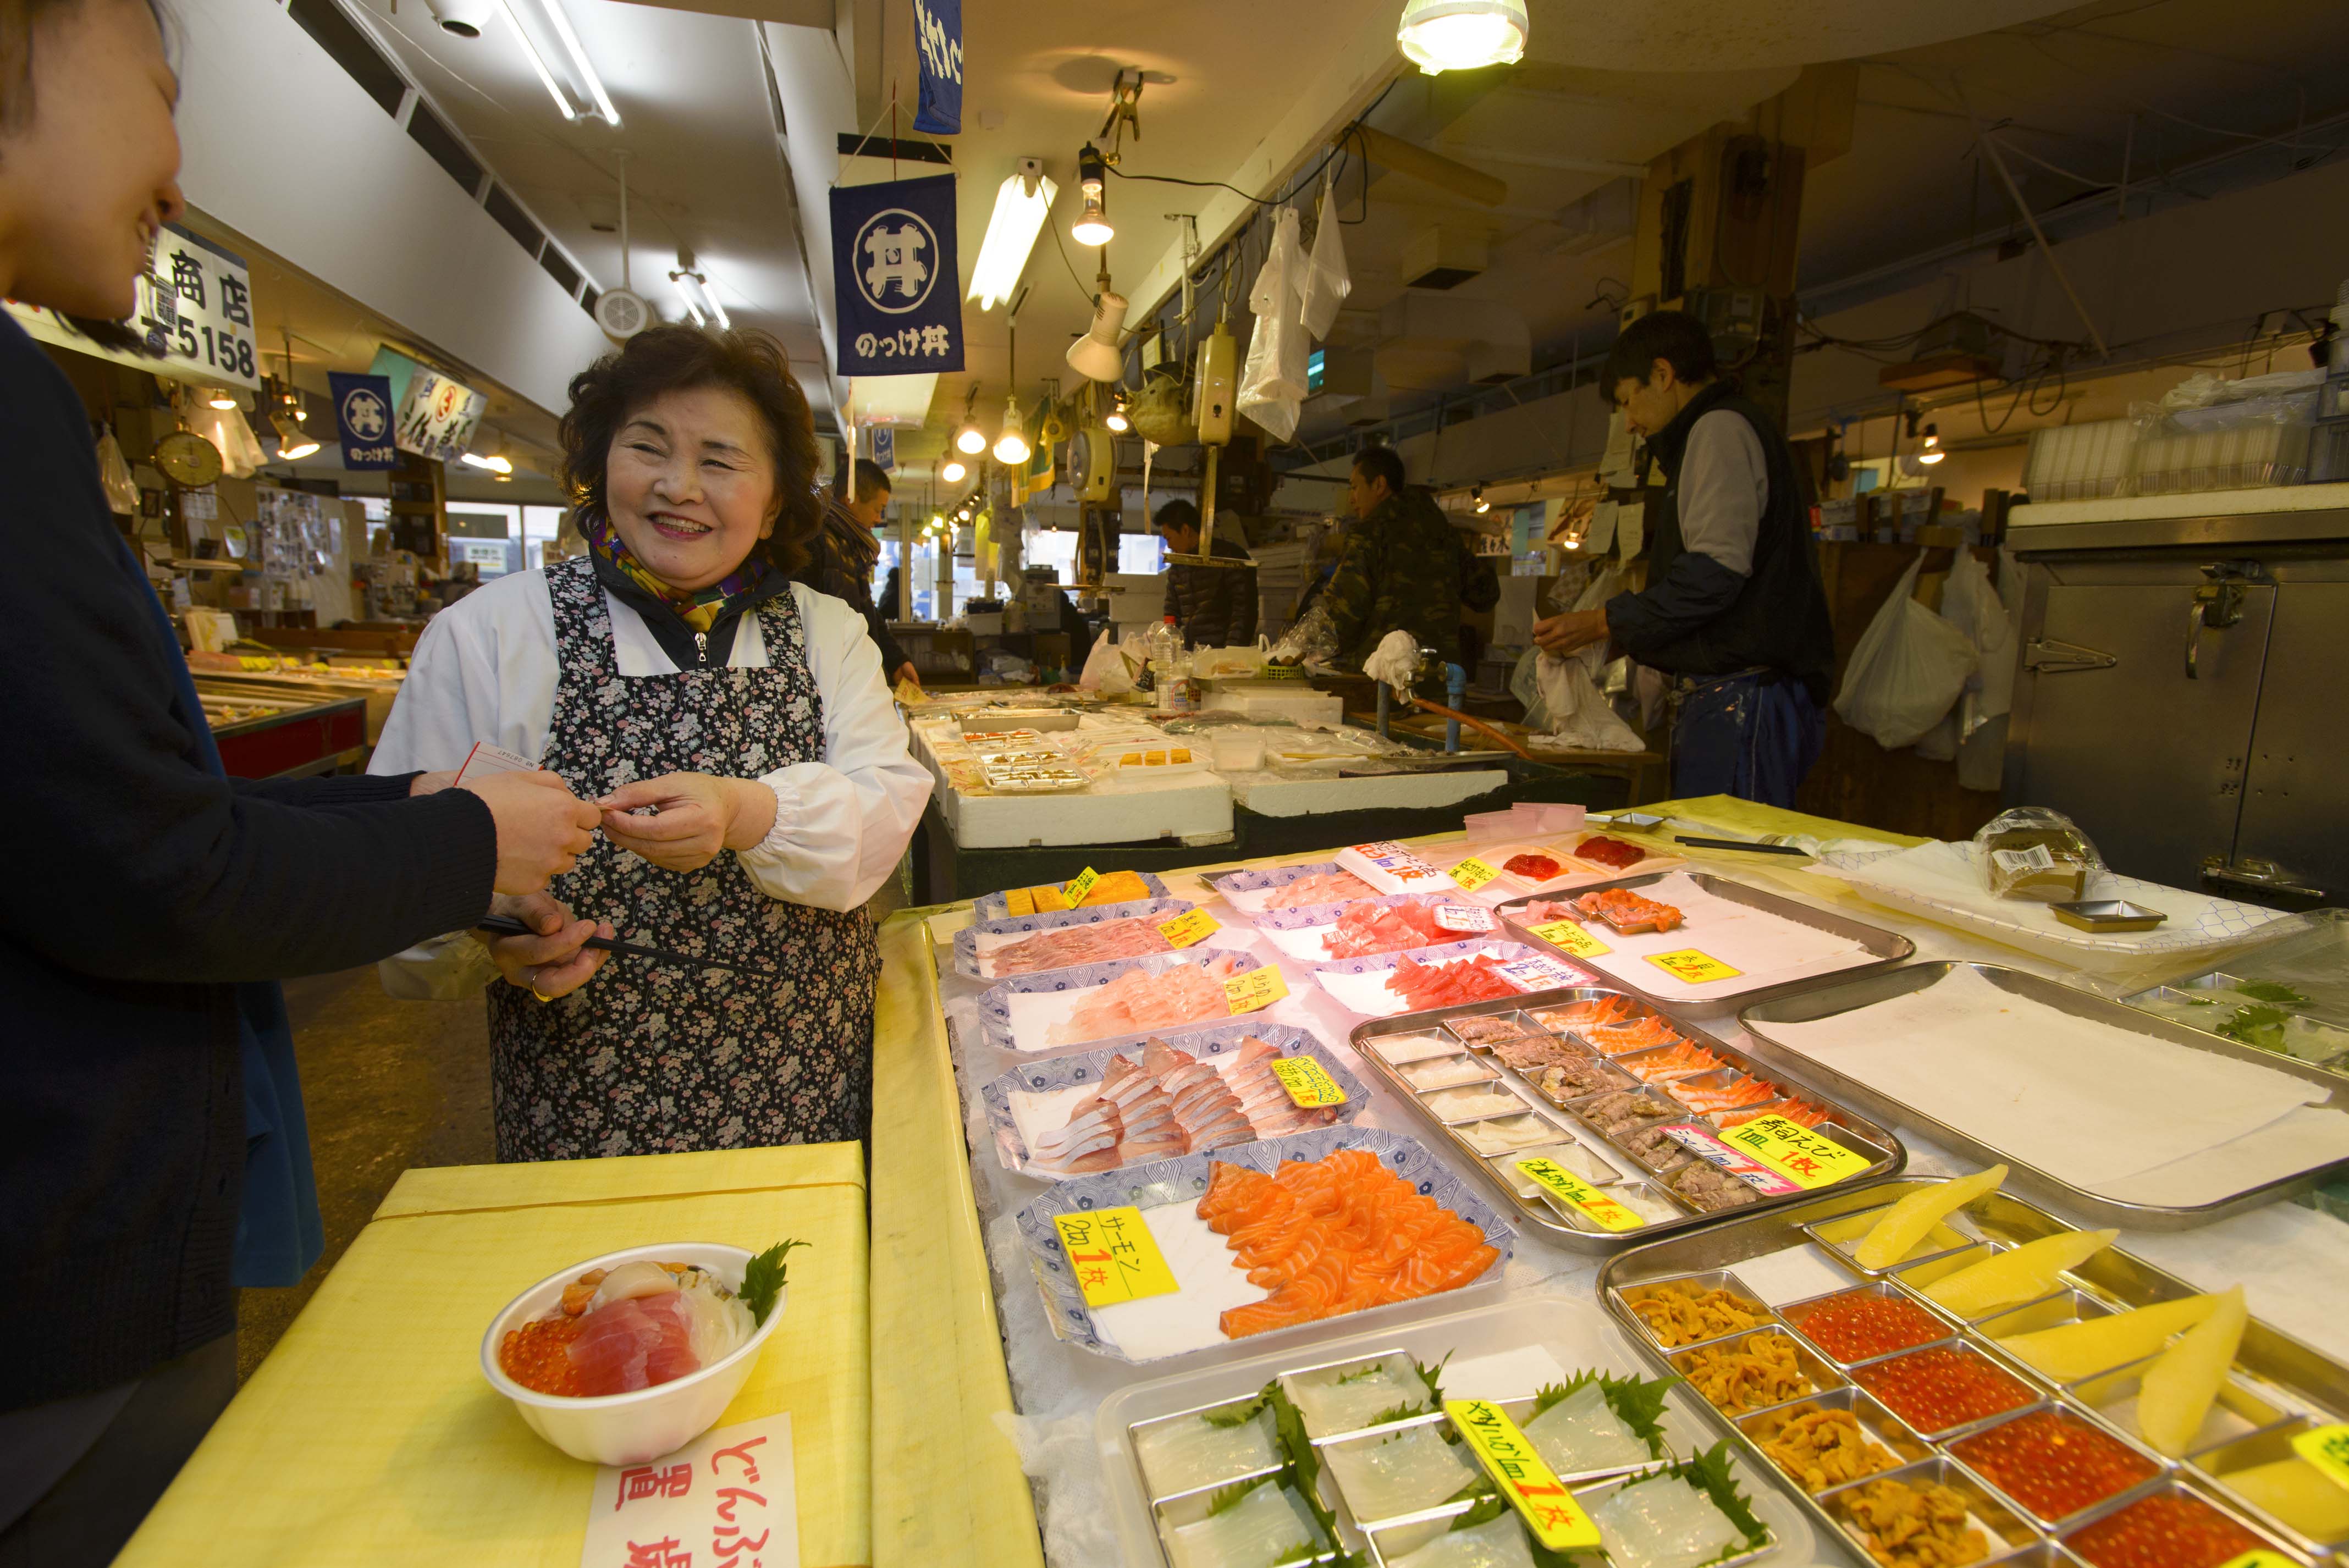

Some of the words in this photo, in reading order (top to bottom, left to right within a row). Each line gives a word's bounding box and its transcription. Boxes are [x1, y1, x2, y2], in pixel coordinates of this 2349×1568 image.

[855, 324, 950, 358] のっけ丼
[1556, 924, 1592, 949] サービス品
[1679, 956, 1715, 969] 赤貝
[1254, 975, 1272, 997] ひらめ
[1735, 1127, 1769, 1150] 1皿
[1781, 1151, 1824, 1178] 1枚
[1755, 1119, 1846, 1160] 寿司えび
[1575, 1197, 1624, 1224] 1枚
[1059, 1220, 1091, 1246] 2切
[1100, 1216, 1141, 1272] サーモン
[1072, 1249, 1113, 1291] 1枚
[1512, 1479, 1576, 1531] 1枚
